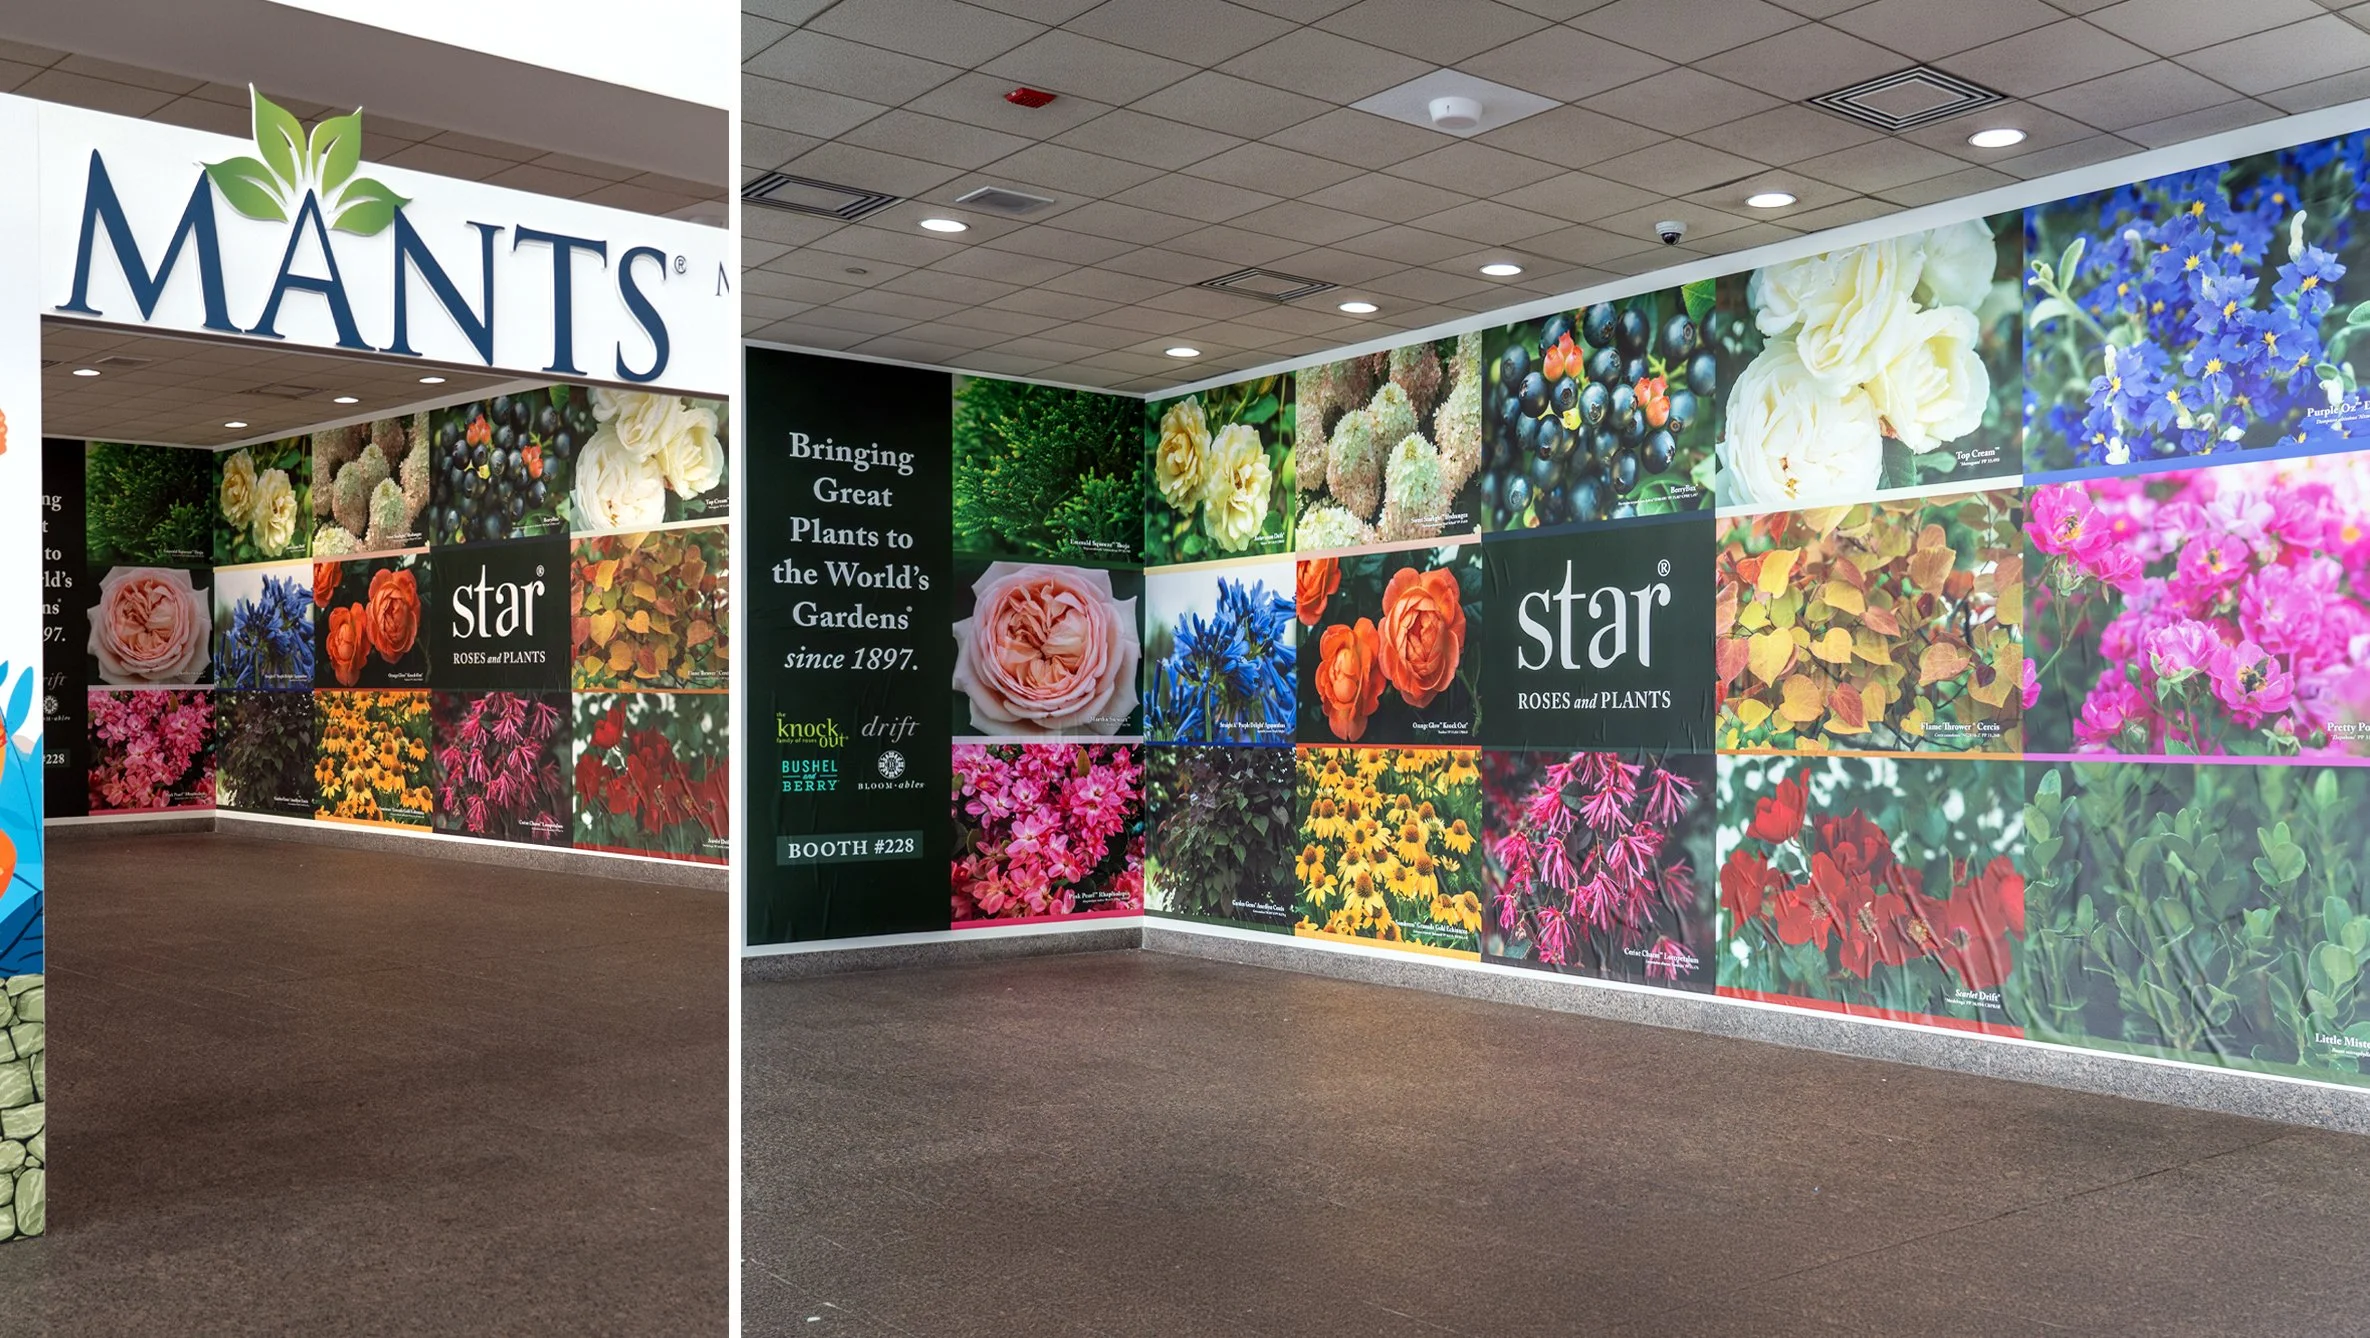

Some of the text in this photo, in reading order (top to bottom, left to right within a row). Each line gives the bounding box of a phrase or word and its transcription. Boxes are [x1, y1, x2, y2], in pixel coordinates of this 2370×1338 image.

[2307, 405, 2339, 419] Purple
[789, 432, 914, 475] Bringing
[1956, 450, 1970, 461] Top
[814, 477, 892, 506] Great
[790, 517, 913, 548] Plants to
[45, 547, 62, 561] to
[42, 570, 73, 589] ld's
[772, 559, 817, 584] the
[453, 650, 546, 665] ROSES and PLANTS
[785, 646, 917, 670] since 1897.
[1518, 690, 1671, 710] ROSES and PLANTS
[776, 718, 839, 738] knock
[861, 715, 920, 743] drift
[1920, 722, 1942, 731] Flame
[1977, 722, 2000, 731] Cercis
[2327, 722, 2357, 734] Pretty
[782, 760, 838, 773] BUSHEL
[802, 772, 817, 780] and
[788, 838, 914, 858] BOOTH #228
[1955, 989, 1978, 999] Scarlet
[2315, 1033, 2342, 1045] Little
